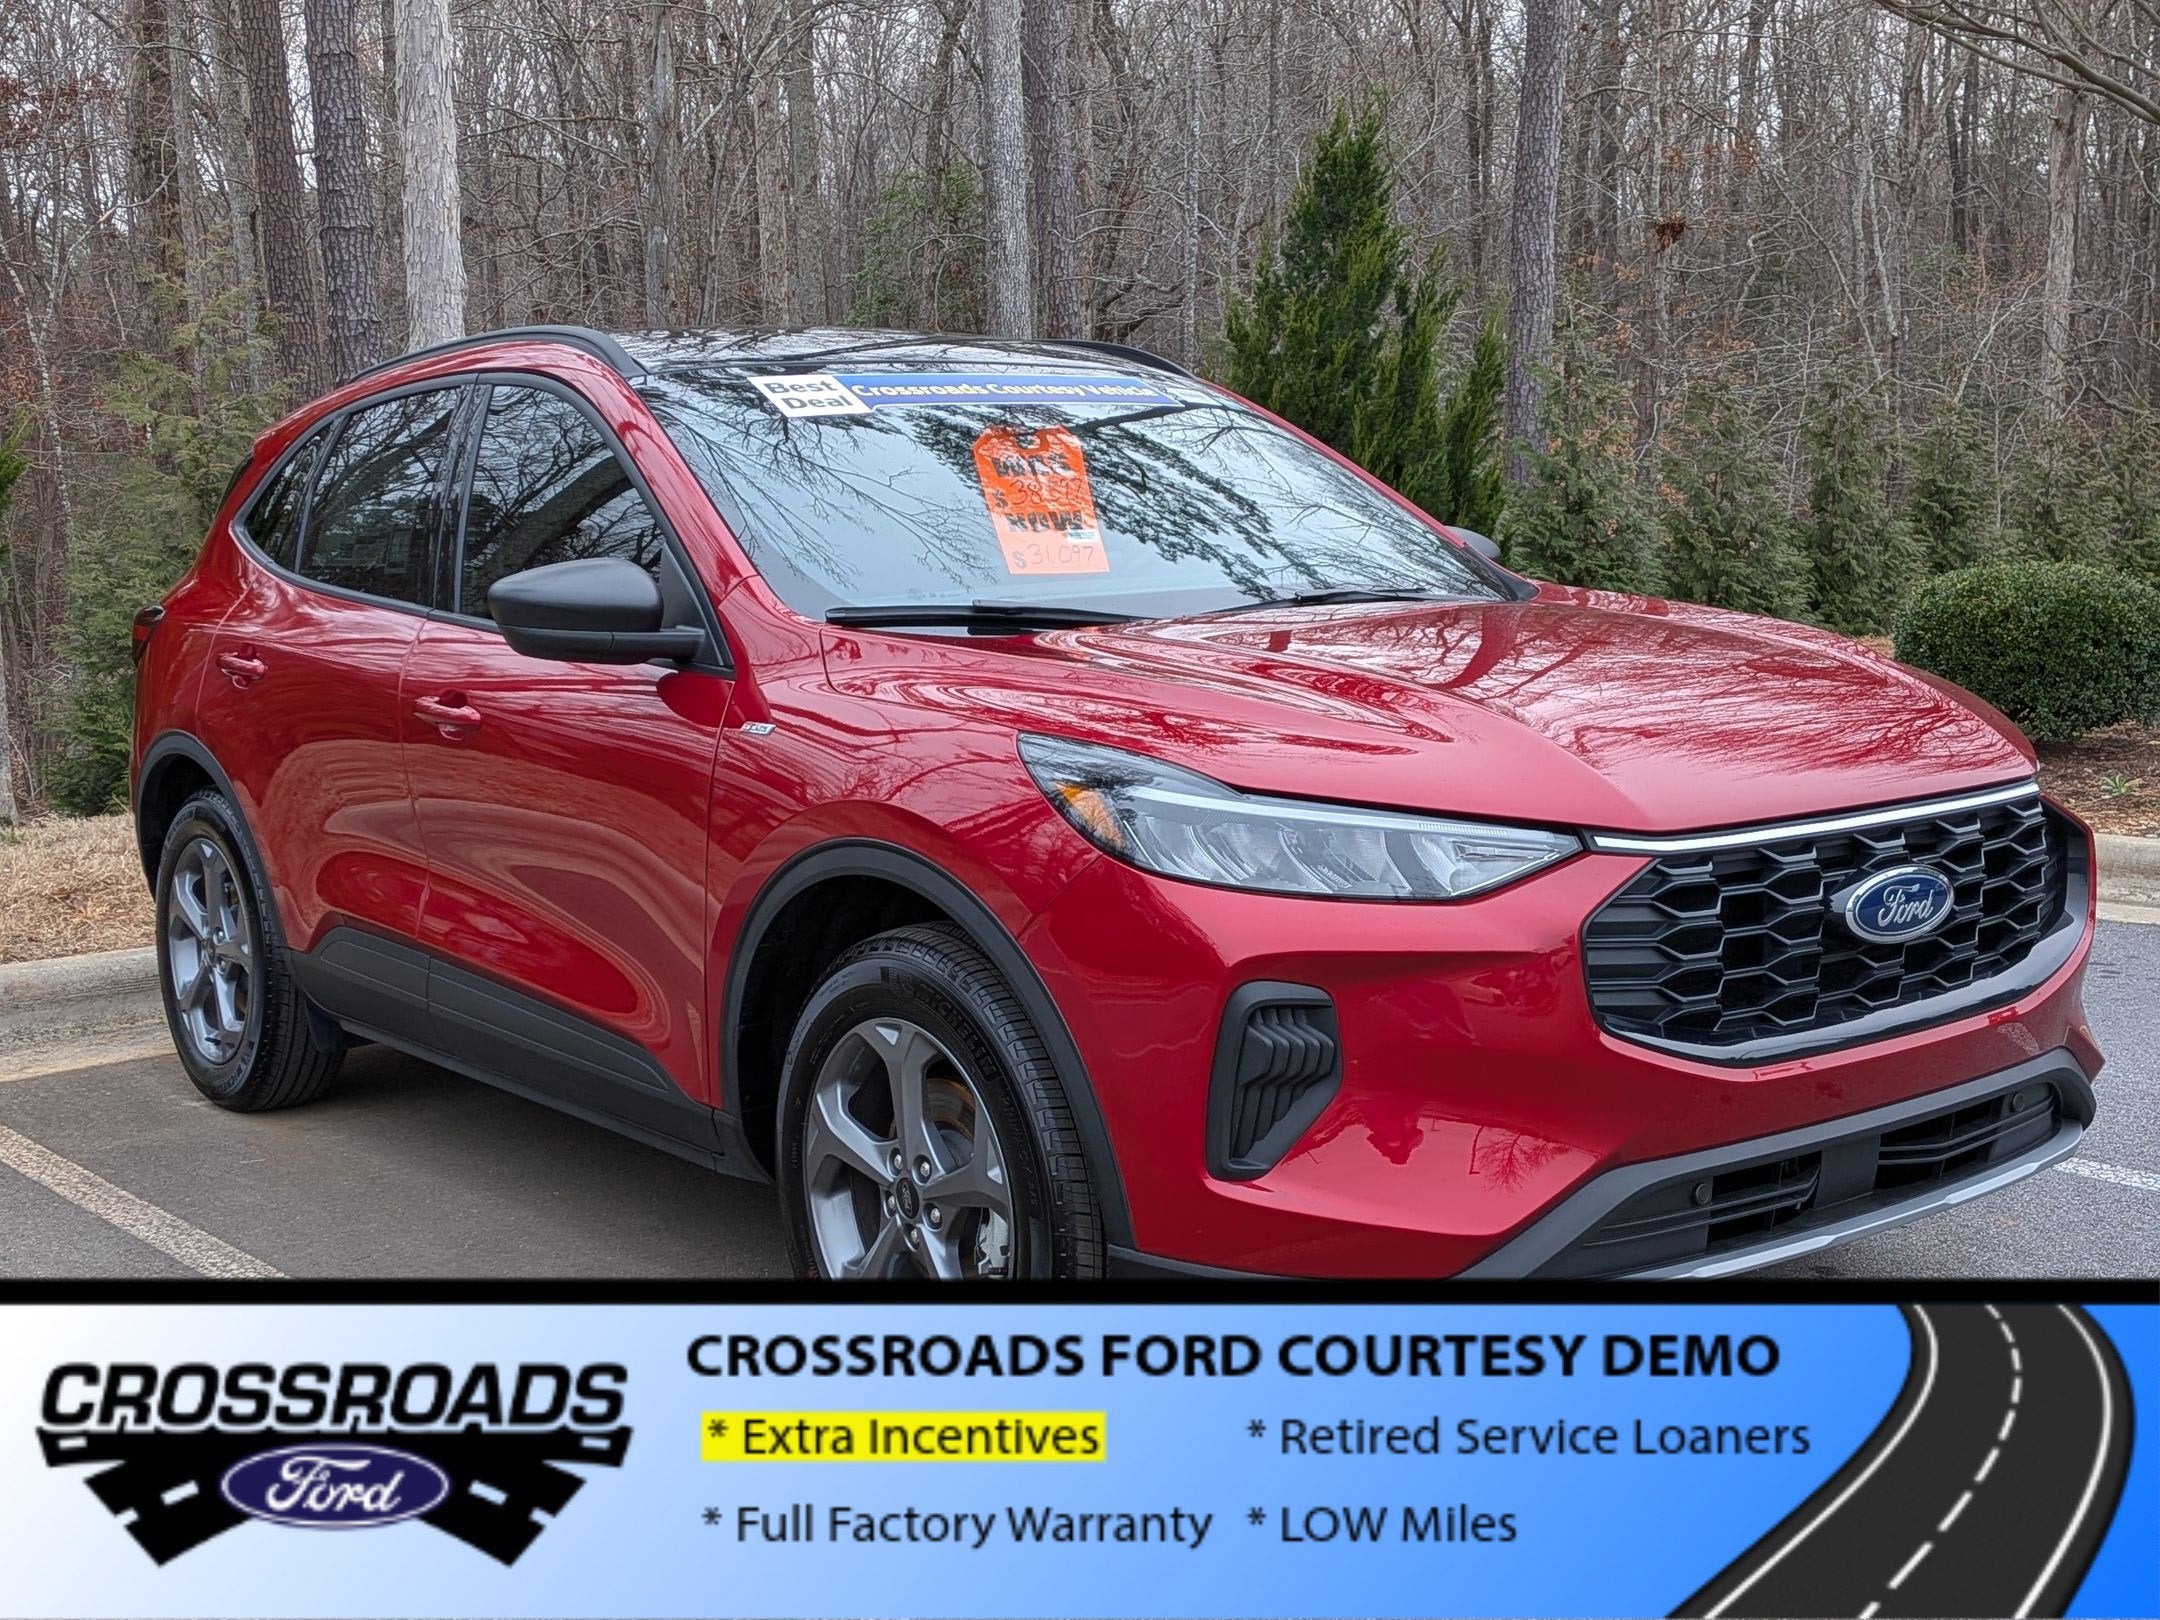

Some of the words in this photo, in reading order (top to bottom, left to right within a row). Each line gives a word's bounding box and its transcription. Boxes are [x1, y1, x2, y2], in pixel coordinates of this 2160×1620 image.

[762, 380, 839, 394] Best
[851, 383, 989, 396] Crossroads
[986, 383, 1086, 397] Courtesy
[1079, 384, 1159, 396] Vehicle
[780, 396, 854, 410] Deal
[1005, 510, 1083, 533] NOW
[1877, 882, 1935, 928] Ford
